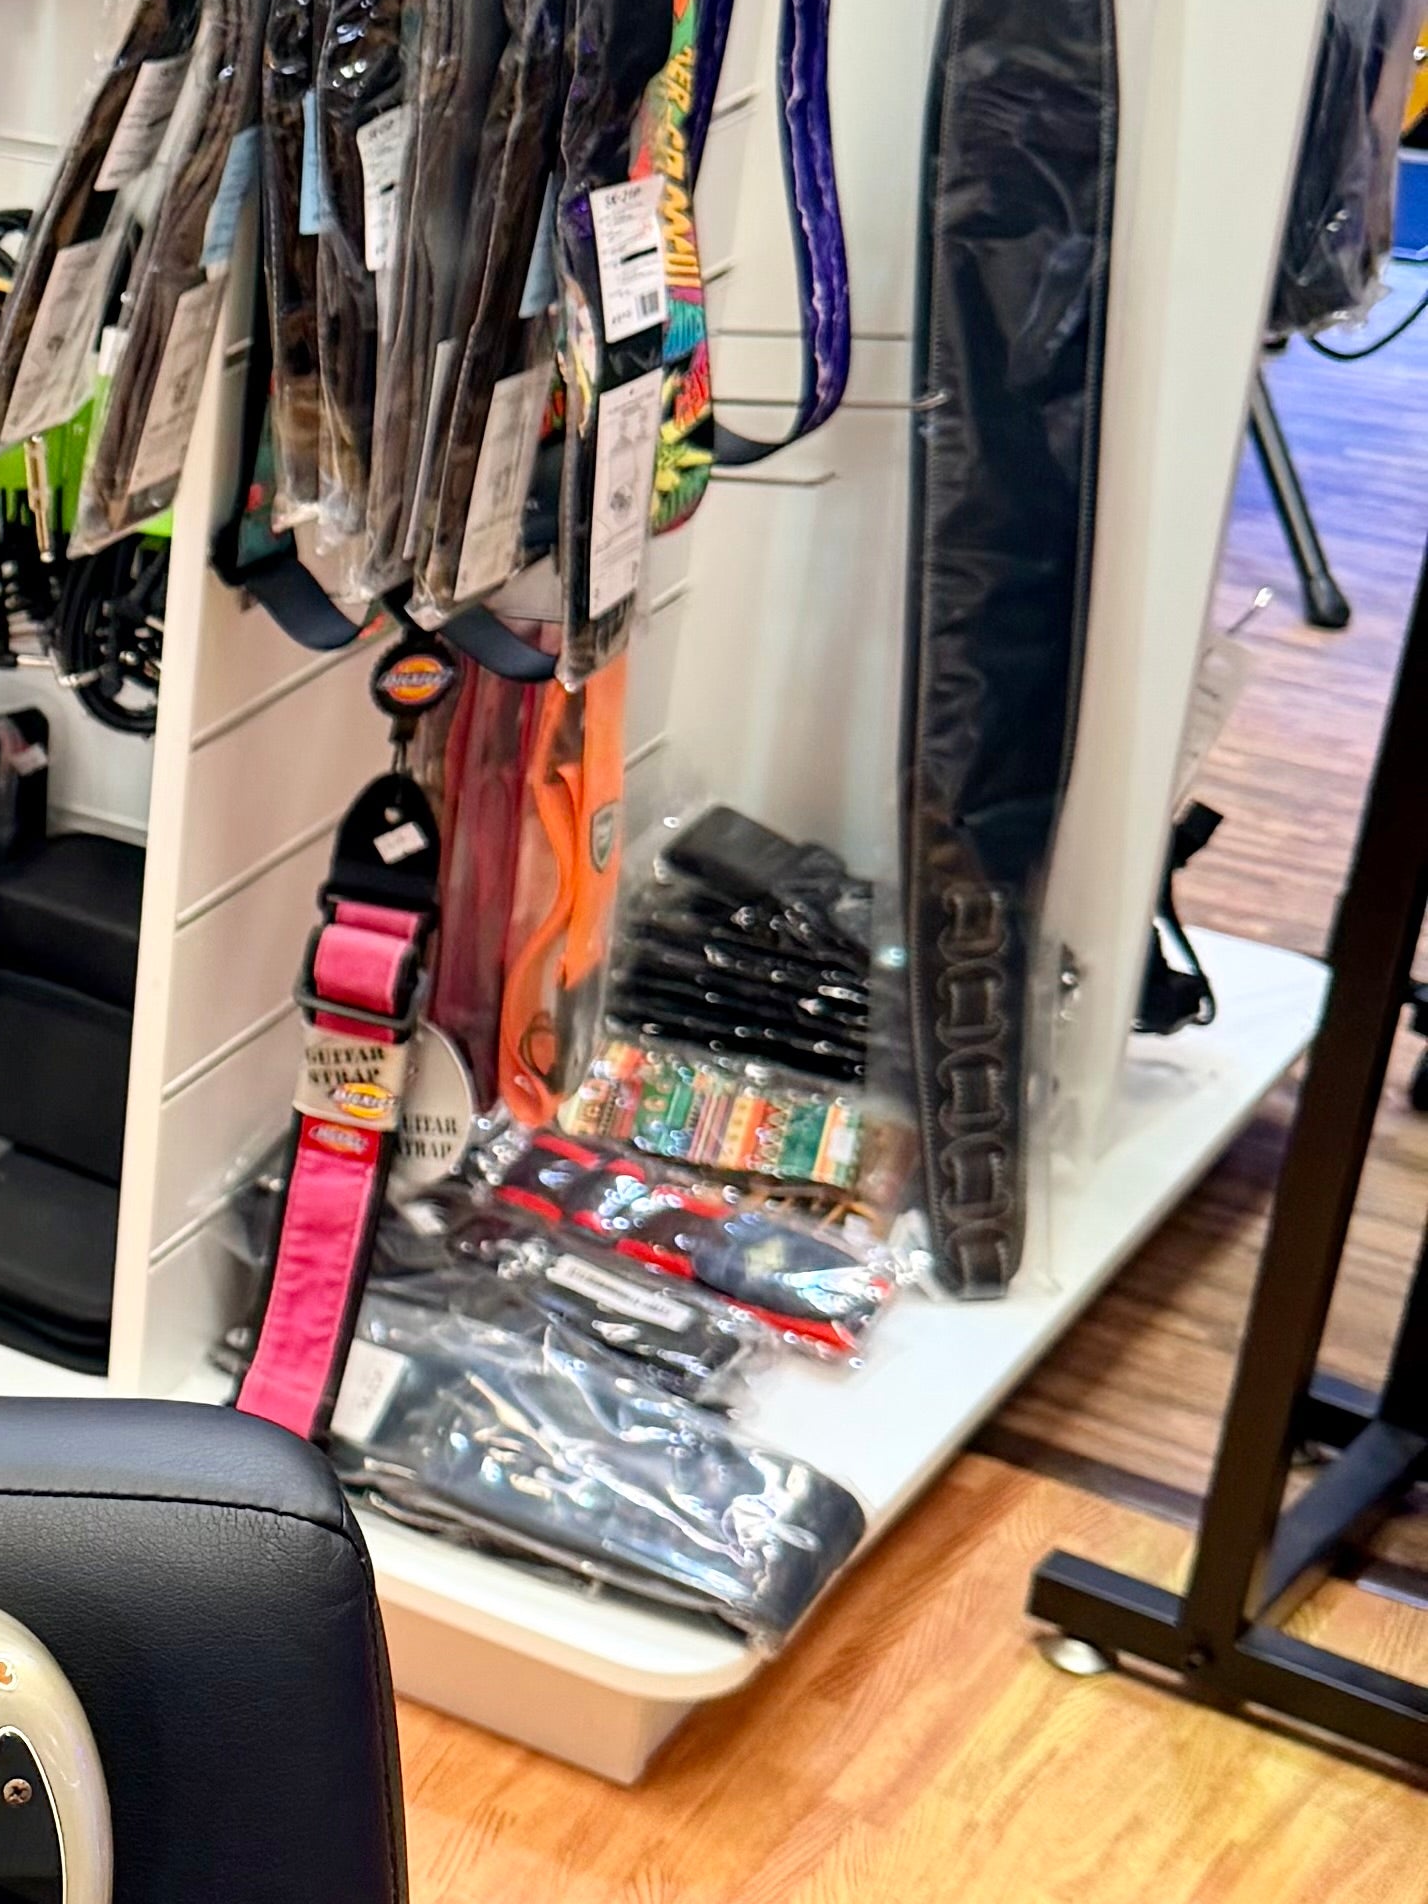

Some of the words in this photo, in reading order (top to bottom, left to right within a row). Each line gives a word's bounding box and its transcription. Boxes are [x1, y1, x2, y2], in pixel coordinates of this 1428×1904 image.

[306, 1047, 385, 1065] GUITAR
[309, 1068, 380, 1084] STRAP
[402, 1112, 458, 1135] UITAR
[399, 1138, 452, 1159] TRAP
